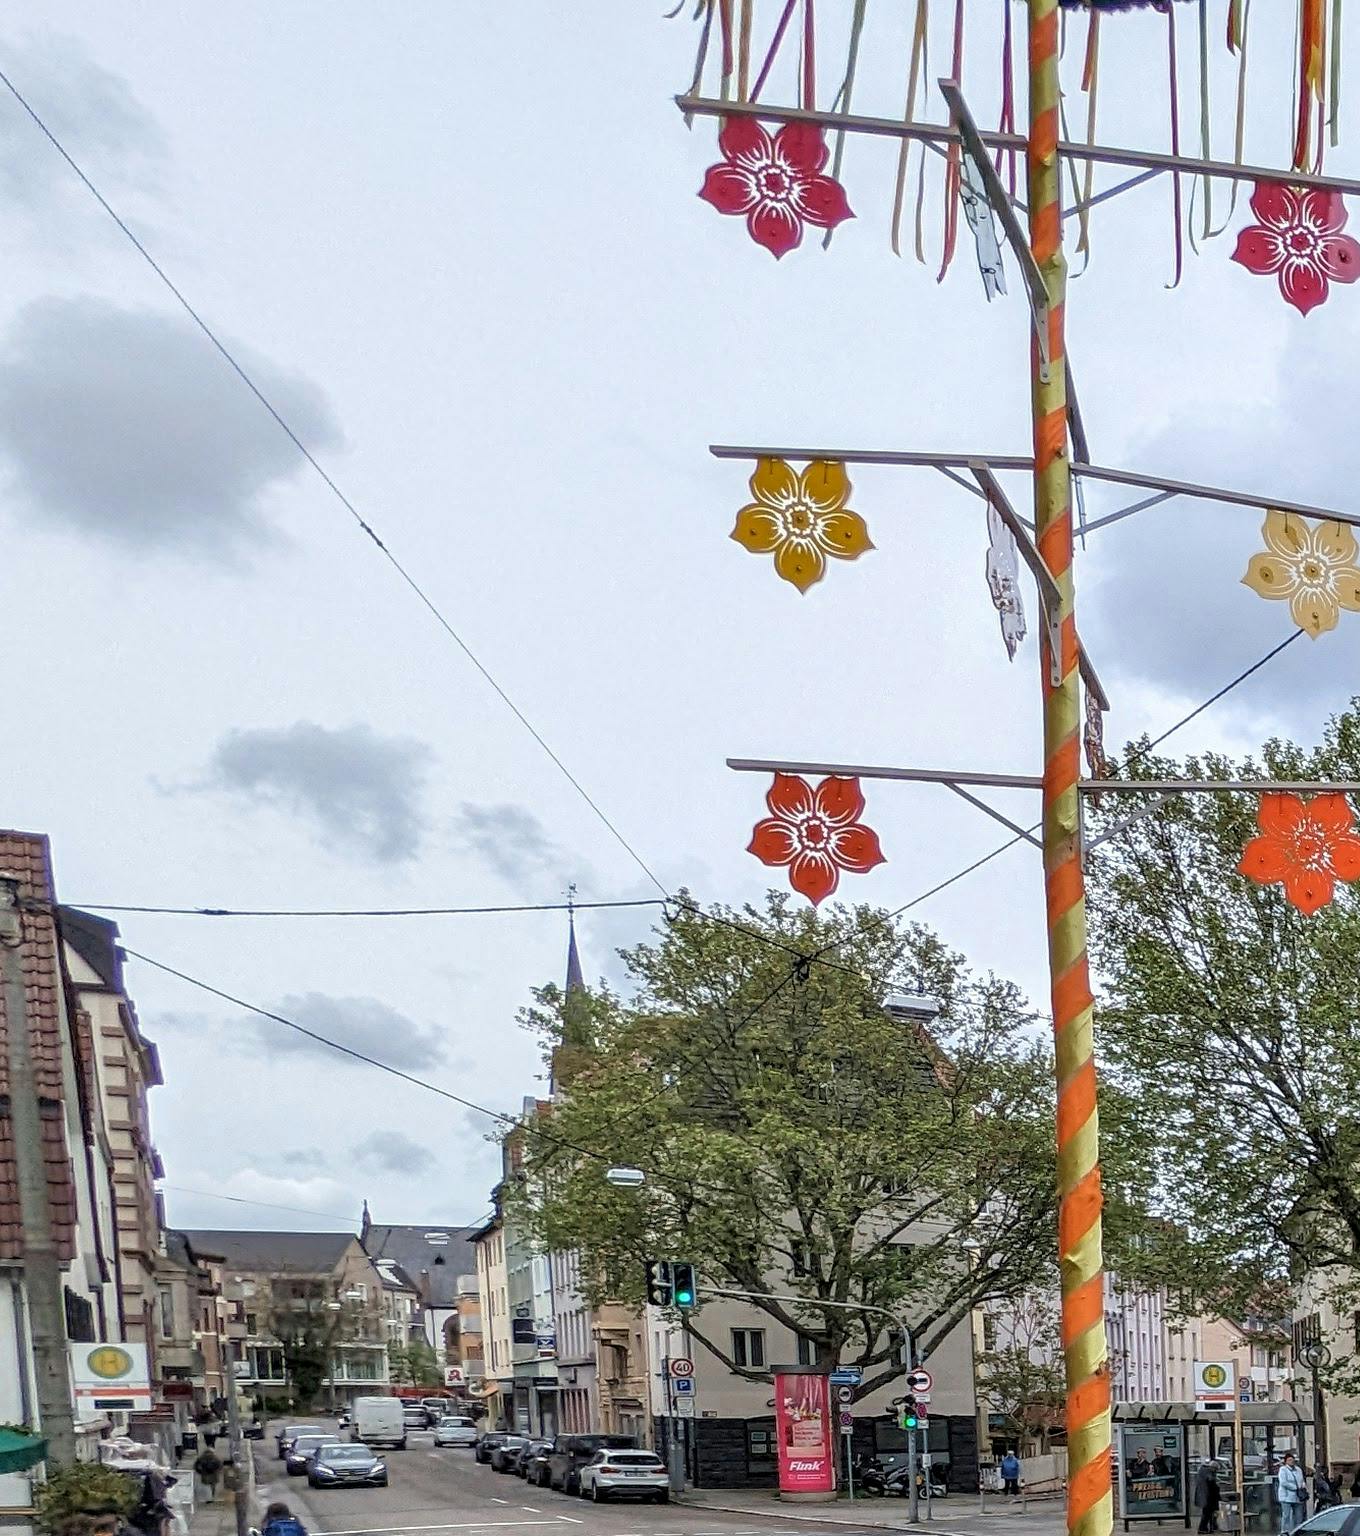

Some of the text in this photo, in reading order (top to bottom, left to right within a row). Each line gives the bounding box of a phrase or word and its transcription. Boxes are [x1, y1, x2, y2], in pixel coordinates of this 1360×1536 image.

[676, 1363, 690, 1372] 40
[679, 1380, 688, 1389] P
[789, 1461, 825, 1471] Flink
